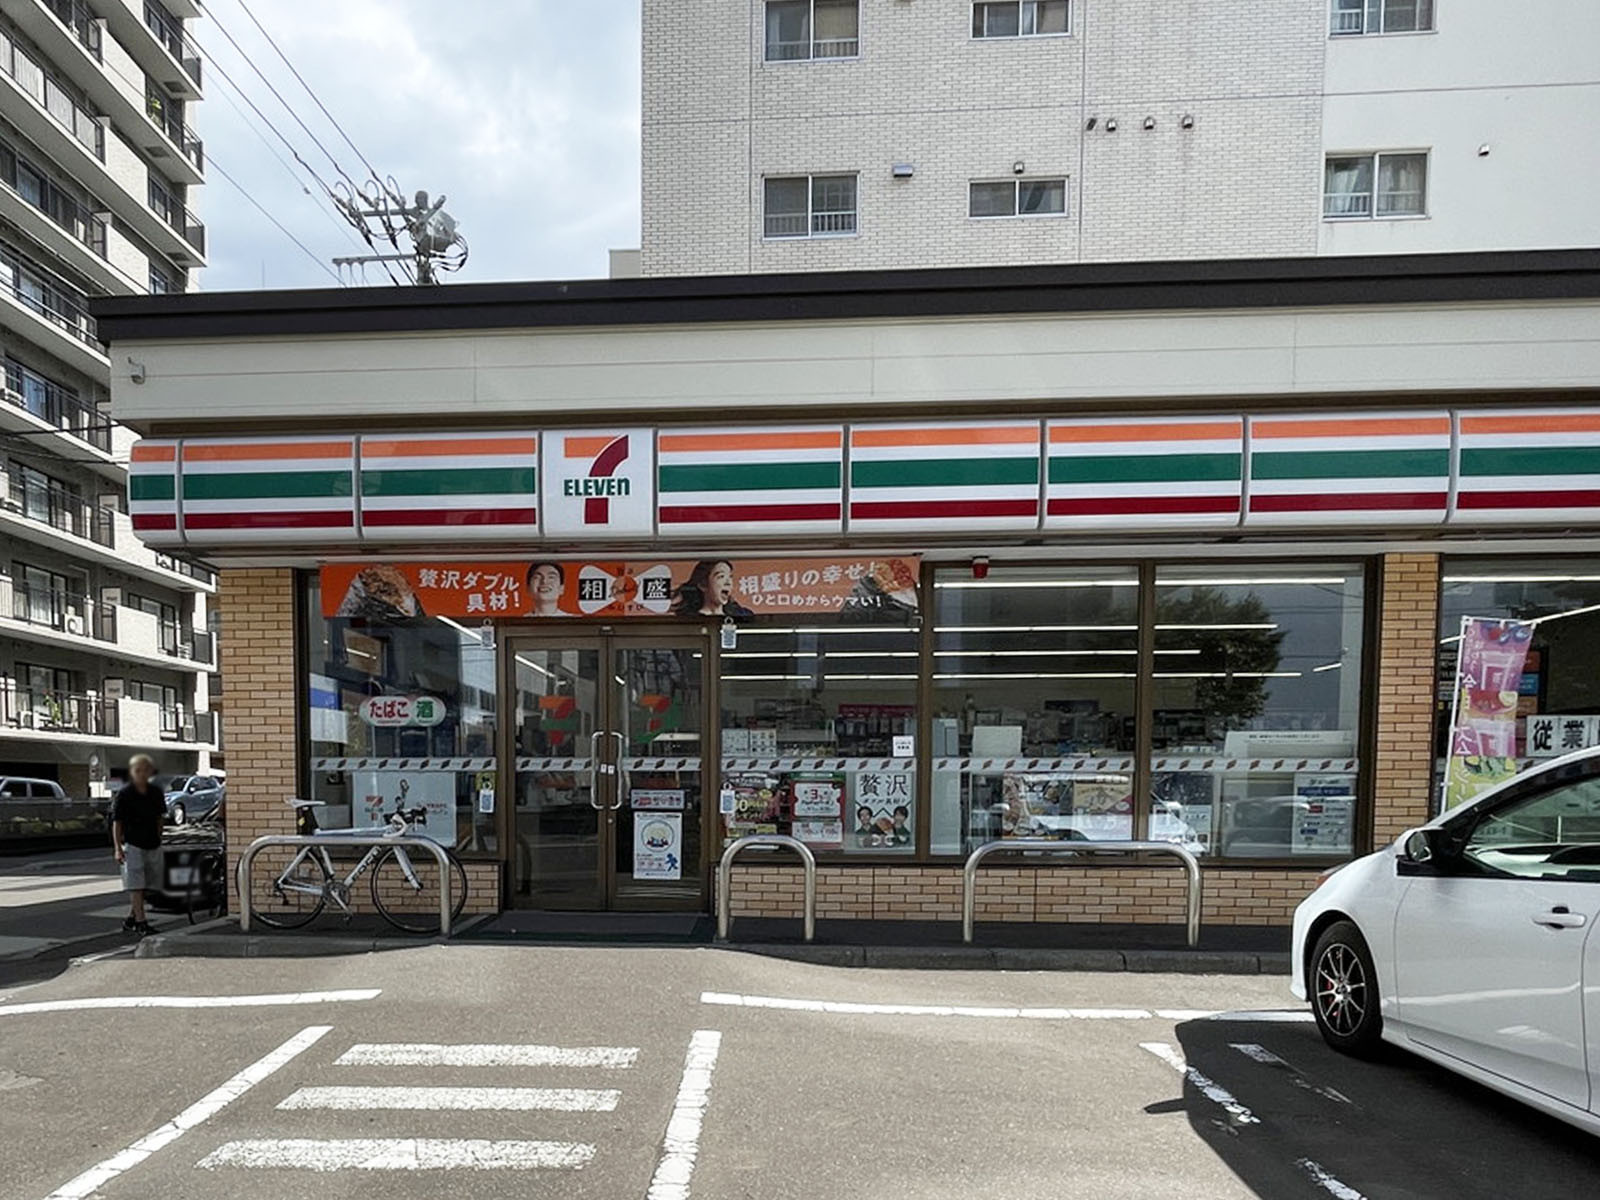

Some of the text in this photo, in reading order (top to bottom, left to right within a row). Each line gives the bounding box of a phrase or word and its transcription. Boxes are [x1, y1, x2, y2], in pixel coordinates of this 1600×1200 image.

[564, 434, 629, 524] 7
[418, 569, 520, 591] 贅沢ダブル
[582, 579, 603, 599] 相
[646, 578, 667, 599] 盛
[467, 591, 520, 613] 具材!
[369, 701, 410, 718] たばこ
[416, 701, 434, 718] 酒
[1533, 720, 1600, 750] 従業
[860, 774, 908, 796] 贅沢
